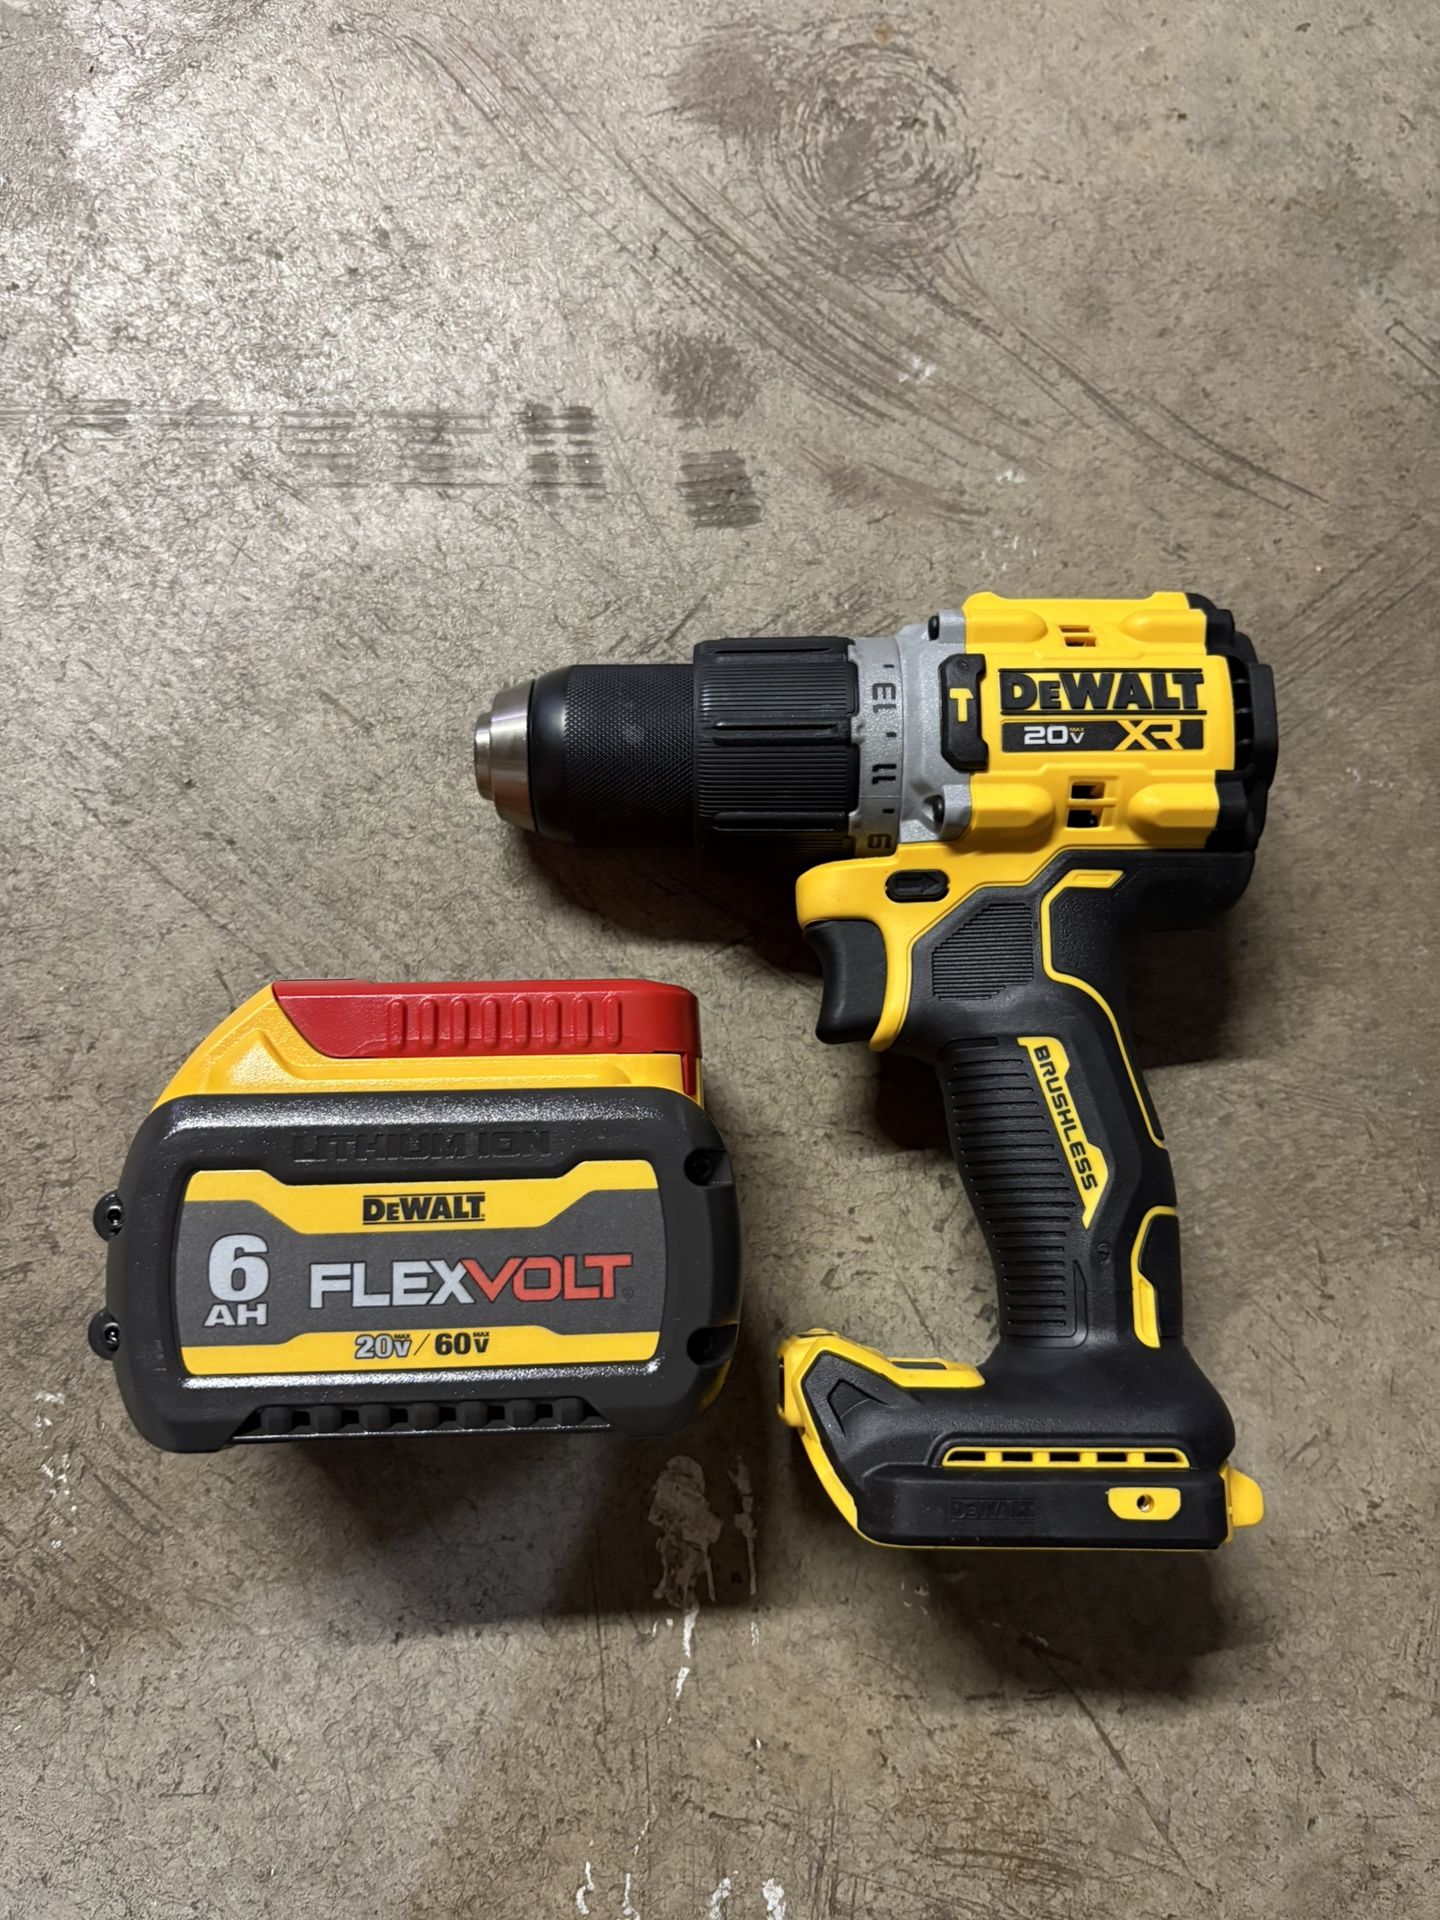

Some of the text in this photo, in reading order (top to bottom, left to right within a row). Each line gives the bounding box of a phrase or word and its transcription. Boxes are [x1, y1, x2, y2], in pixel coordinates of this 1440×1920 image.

[872, 682, 897, 714] 13
[1113, 719, 1184, 751] XR
[871, 763, 897, 785] 11
[1033, 1045, 1098, 1191] BRUSHLESS
[293, 1130, 552, 1164] LITHIUM ION
[207, 1234, 270, 1301] 6
[309, 1253, 633, 1309] FLEXVOLT
[202, 1303, 268, 1327] AH
